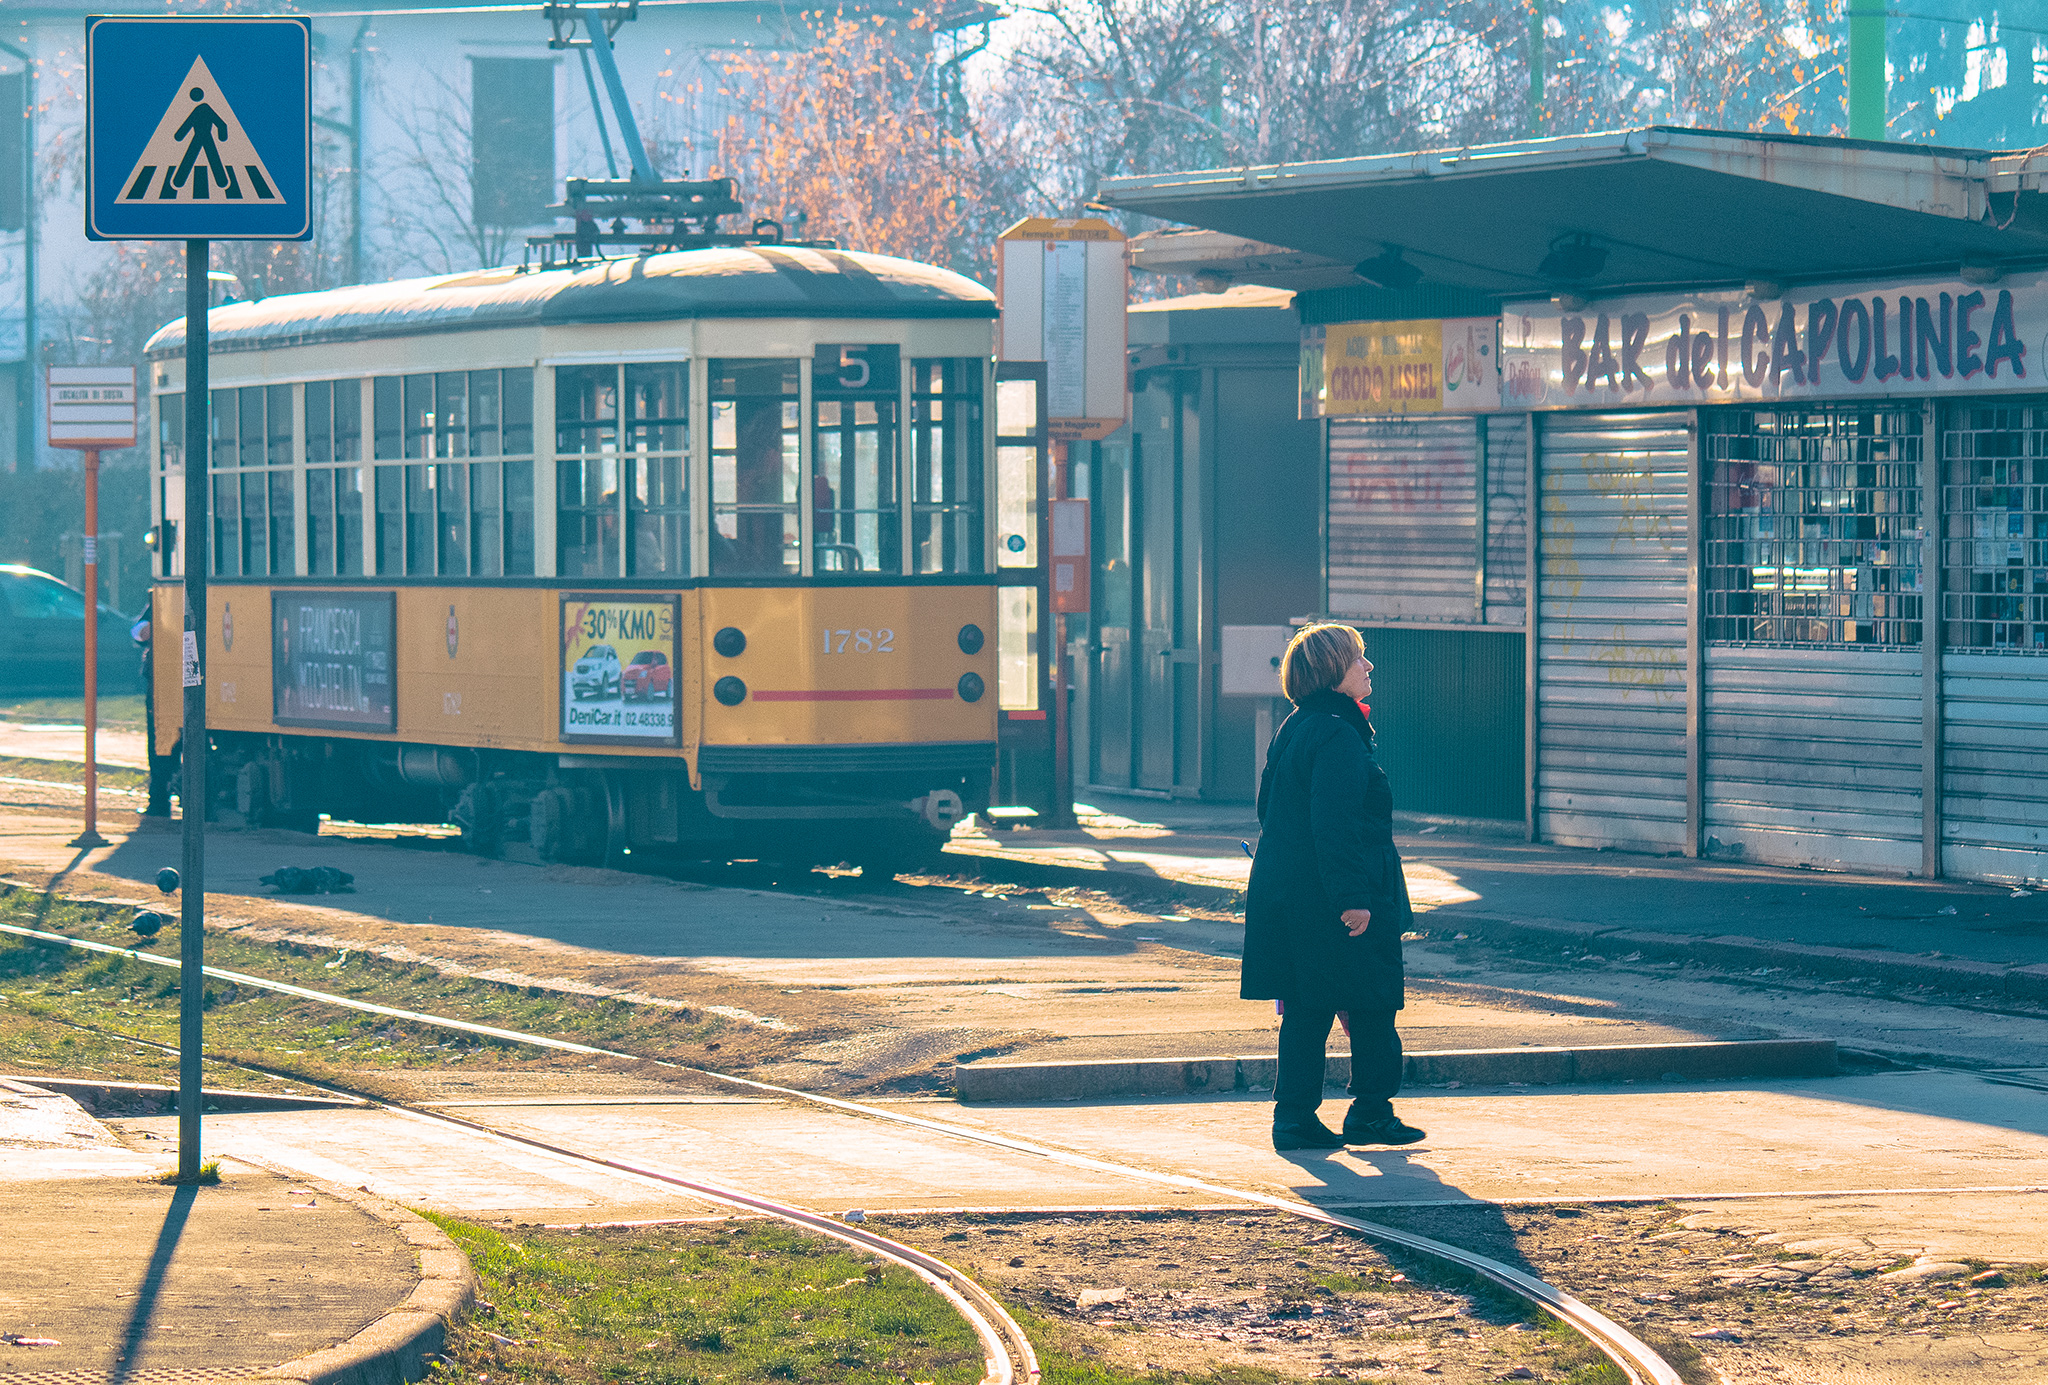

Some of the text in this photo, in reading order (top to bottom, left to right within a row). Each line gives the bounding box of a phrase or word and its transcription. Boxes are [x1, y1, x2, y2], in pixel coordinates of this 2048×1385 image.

[1561, 312, 1654, 396] BAR
[1666, 306, 1729, 391] del
[1741, 290, 2027, 386] CAPOLINEA
[839, 345, 870, 387] 5
[1331, 365, 1384, 402] CRODO
[1389, 362, 1437, 400] LISIEL
[822, 628, 896, 655] 1782
